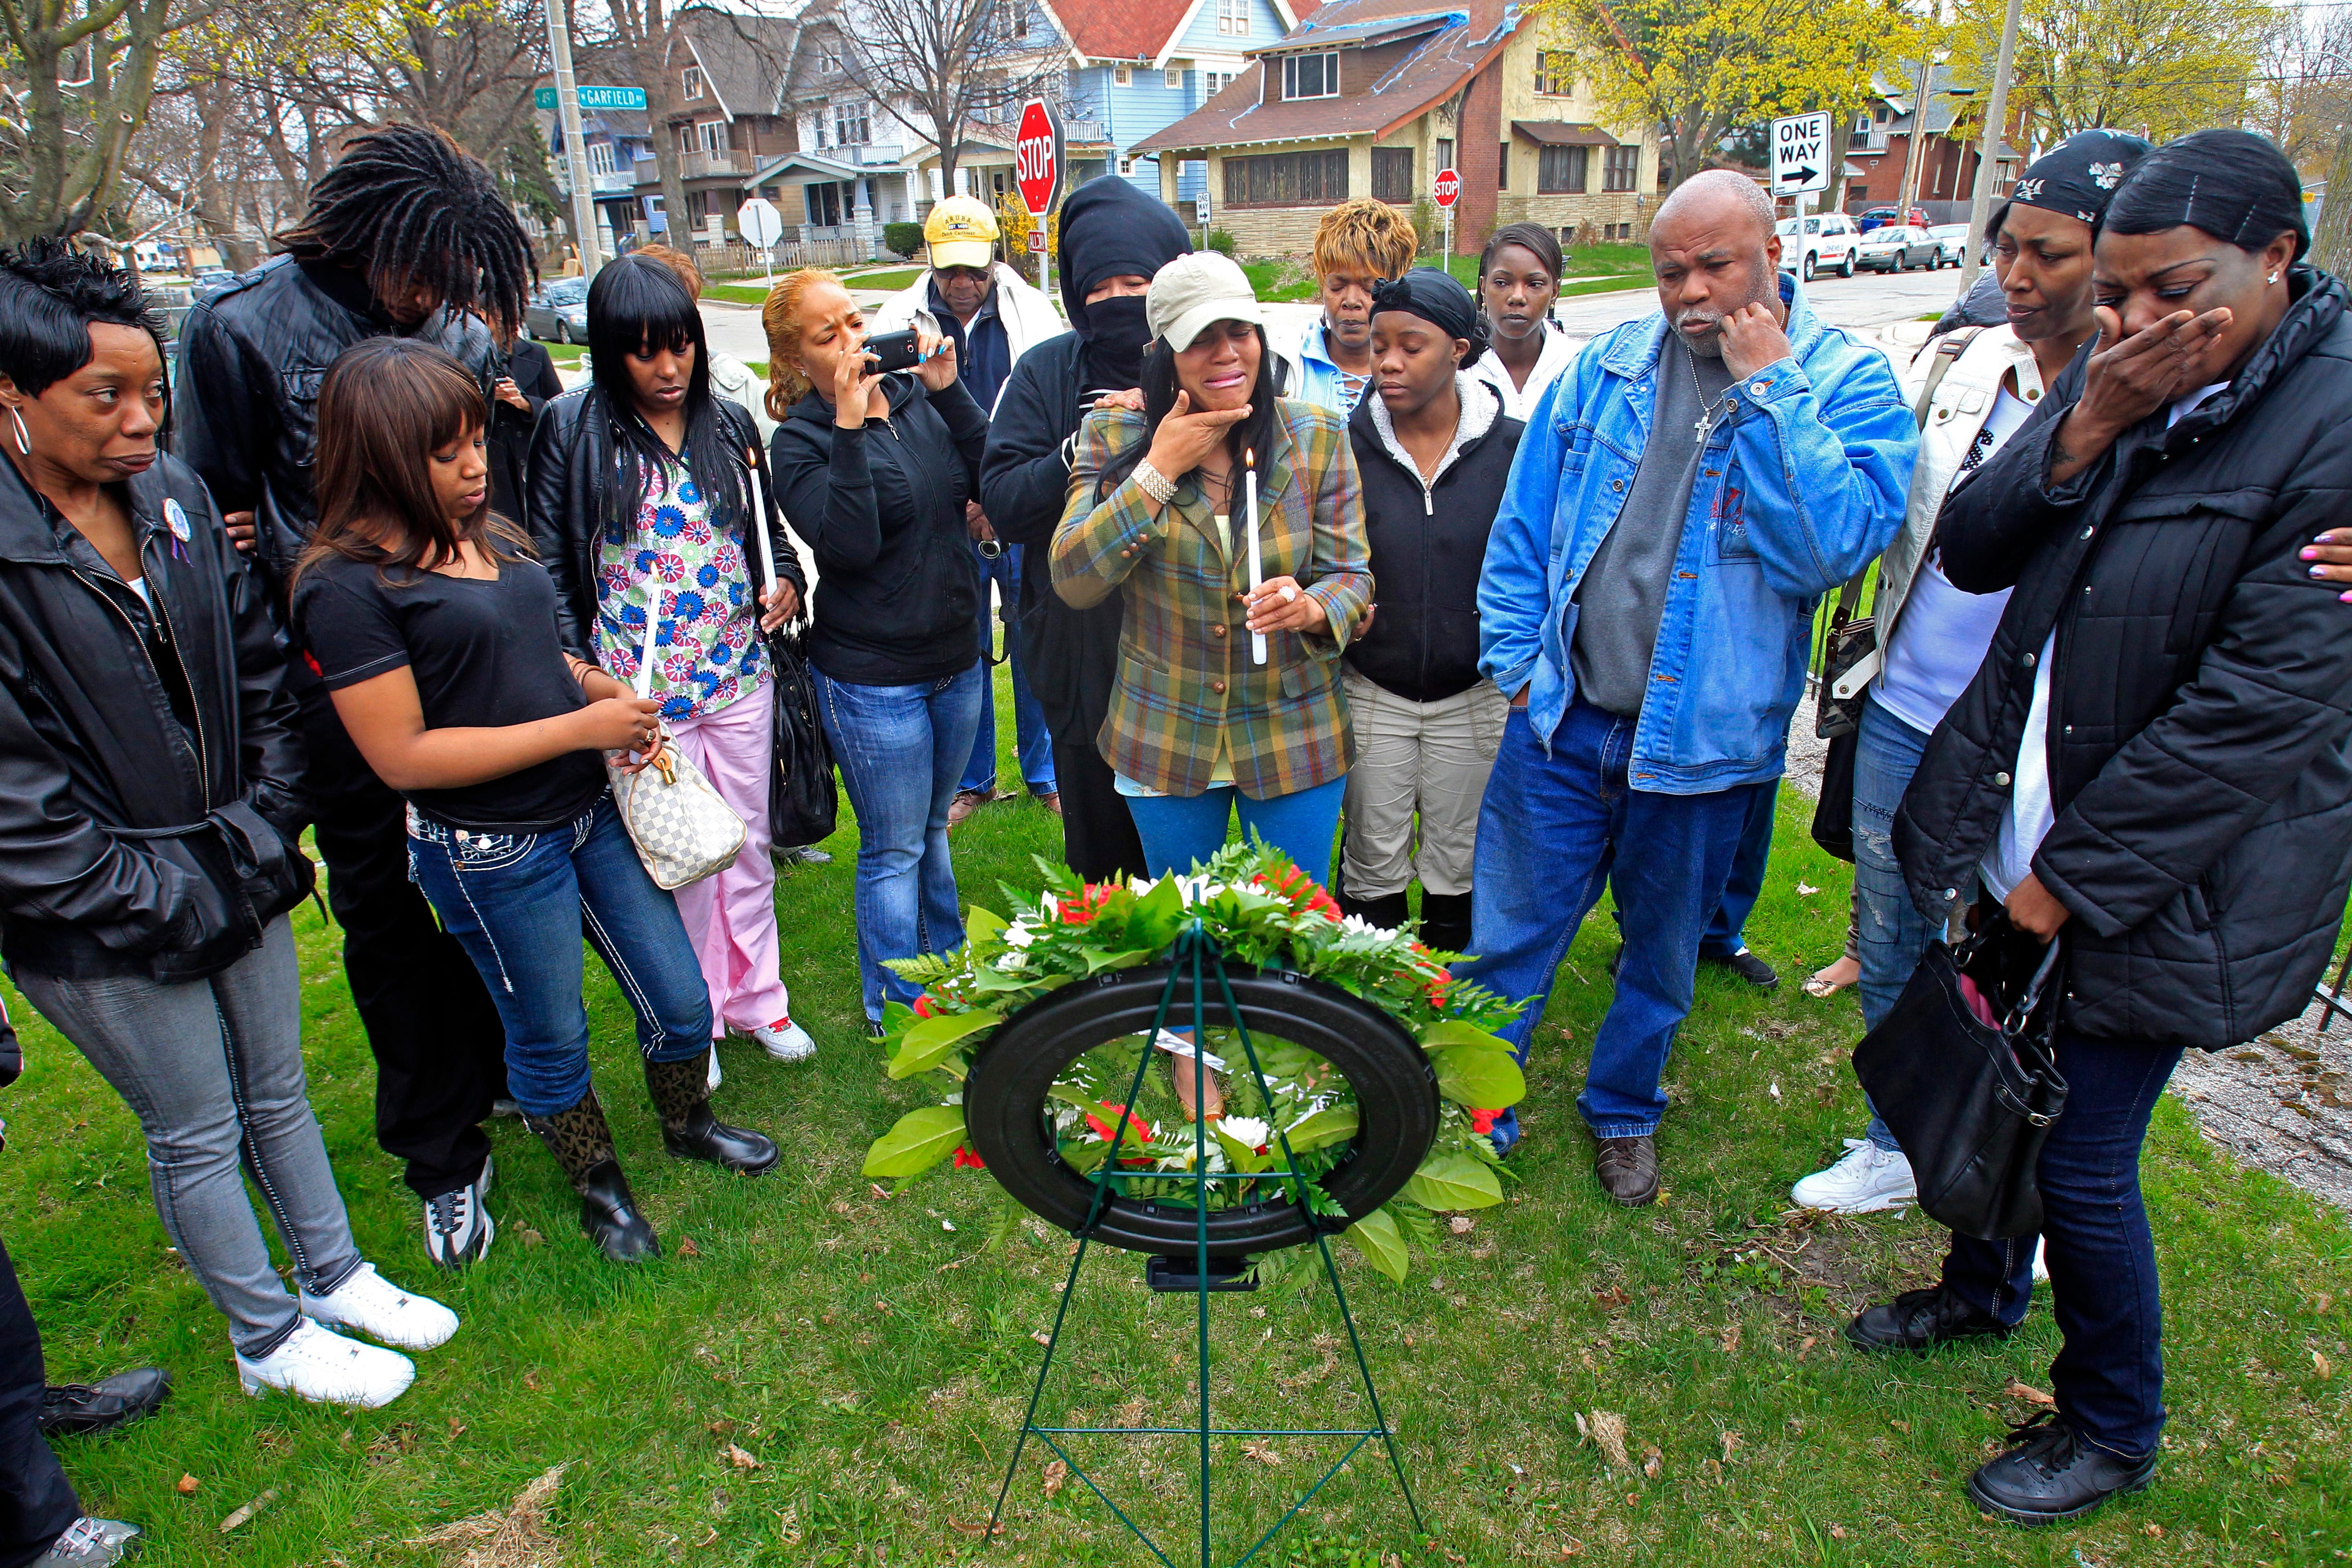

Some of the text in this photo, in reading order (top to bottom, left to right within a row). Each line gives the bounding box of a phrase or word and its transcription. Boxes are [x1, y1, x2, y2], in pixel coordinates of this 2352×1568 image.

[587, 89, 635, 105] GARFIELD
[1780, 120, 1821, 142] ONE
[1017, 135, 1053, 182] STOP
[1780, 141, 1821, 164] WAY
[1434, 181, 1458, 196] STOP
[1199, 203, 1208, 211] WAY
[945, 215, 970, 224] ARUBA
